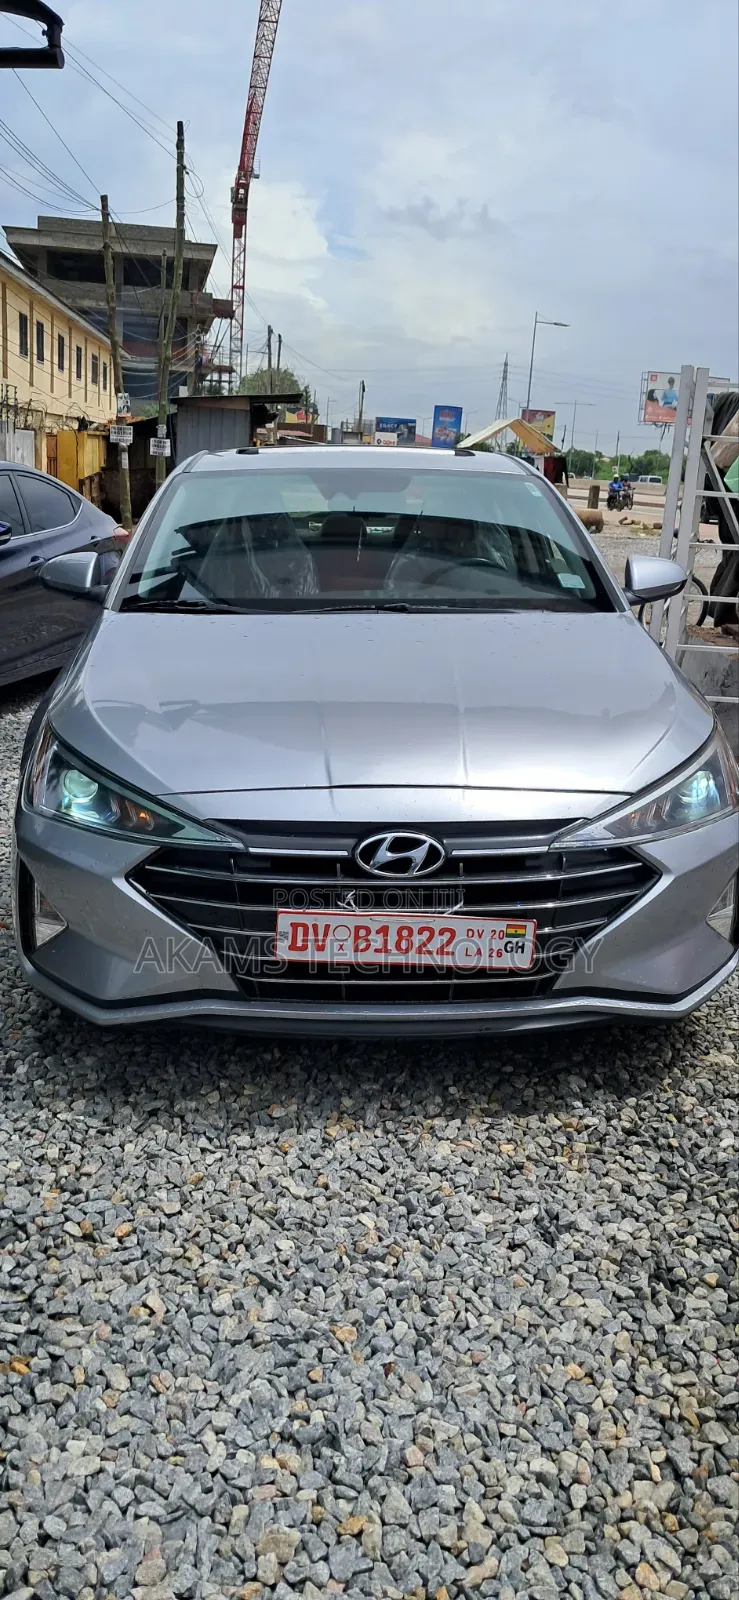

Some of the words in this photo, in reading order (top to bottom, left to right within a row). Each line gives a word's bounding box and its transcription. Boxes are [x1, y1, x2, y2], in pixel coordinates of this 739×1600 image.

[288, 922, 331, 952] DV
[353, 924, 457, 956] B1822
[466, 928, 485, 939] DV
[490, 929, 505, 940] 20
[465, 947, 483, 957] LA
[488, 948, 503, 958] 26
[504, 940, 526, 954] GH
